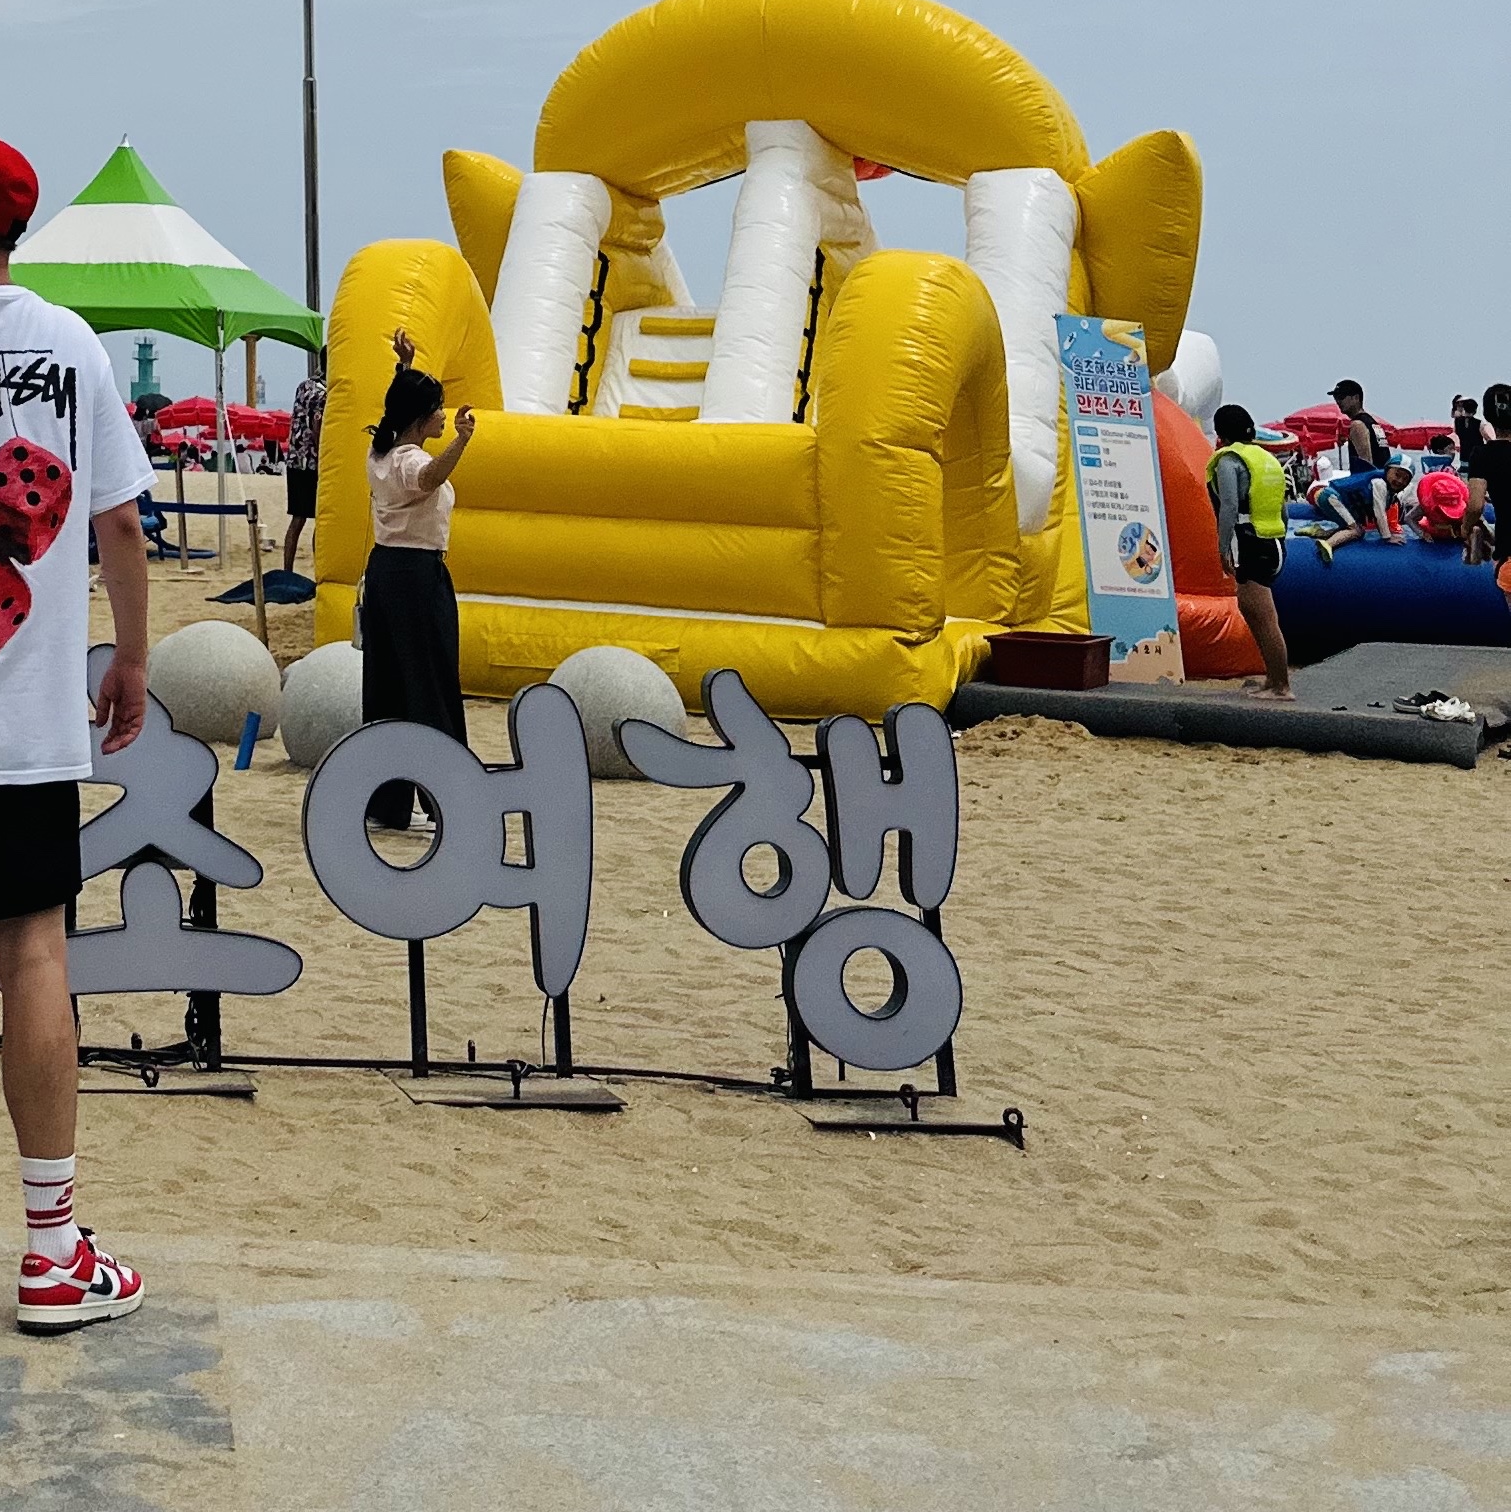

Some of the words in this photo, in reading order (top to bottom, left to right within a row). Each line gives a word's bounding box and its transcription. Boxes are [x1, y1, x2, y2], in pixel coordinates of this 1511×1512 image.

[1073, 358, 1138, 378] 속초해수욕장
[1074, 375, 1095, 391] 워터
[1076, 394, 1144, 420] 안전수칙
